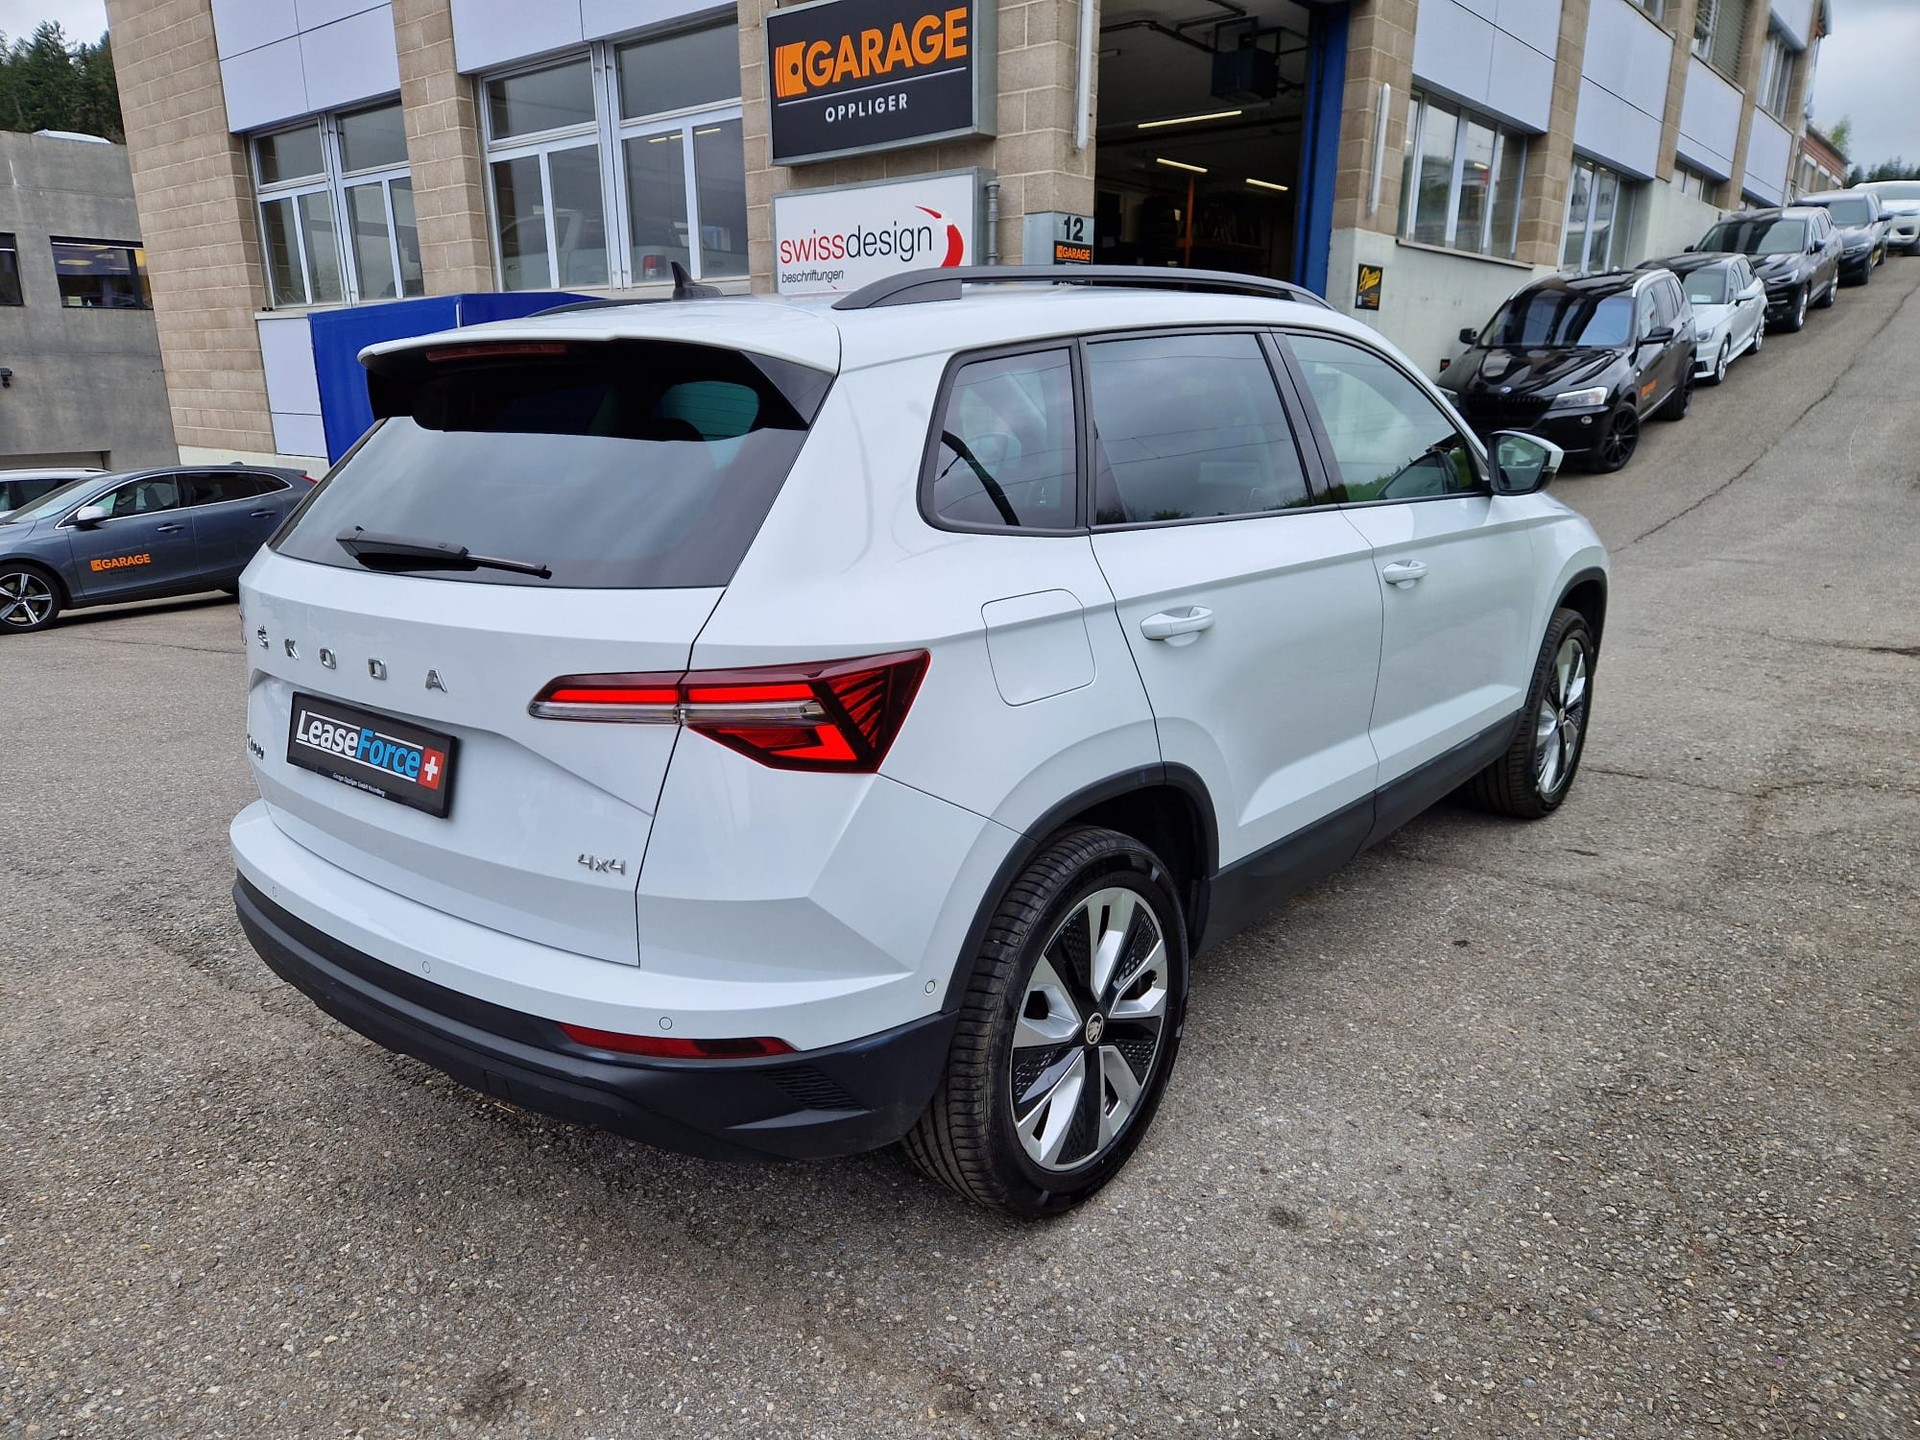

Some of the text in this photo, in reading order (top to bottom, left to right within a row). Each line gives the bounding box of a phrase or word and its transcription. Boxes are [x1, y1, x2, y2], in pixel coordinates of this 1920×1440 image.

[805, 6, 968, 87] GARAGE
[824, 92, 908, 123] OPPLIGER
[780, 220, 932, 264] swissdesign
[1063, 215, 1084, 243] 12
[1062, 246, 1091, 261] GARAGE
[781, 268, 844, 284] beschriftungen
[101, 553, 151, 569] GARAGE
[296, 709, 421, 779] LeaseForce
[577, 853, 626, 876] 4x4
